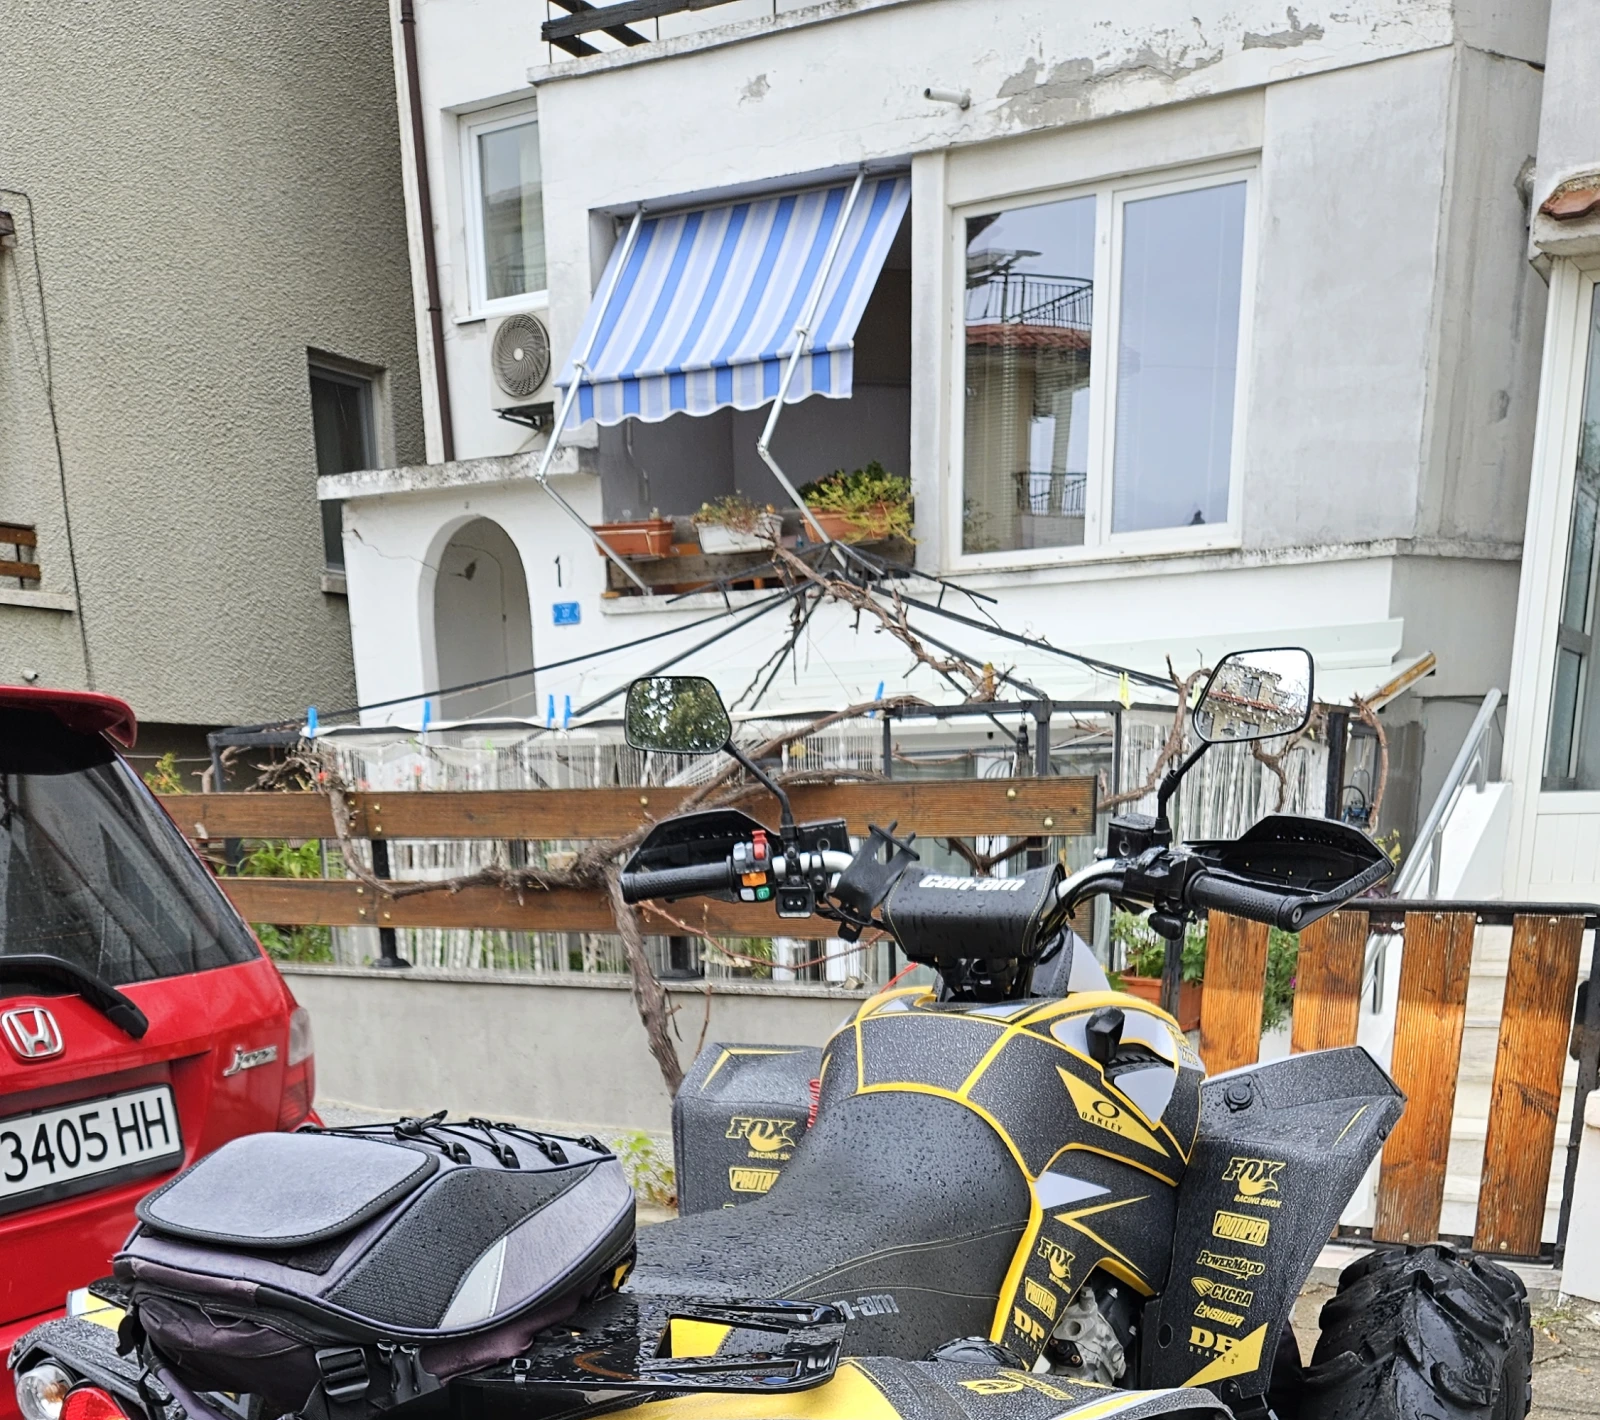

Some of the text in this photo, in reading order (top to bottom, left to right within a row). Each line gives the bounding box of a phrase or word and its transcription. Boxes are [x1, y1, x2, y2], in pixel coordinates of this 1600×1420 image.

[725, 1116, 797, 1145] FOX
[1081, 1111, 1123, 1132] OAKLEY
[0, 1097, 170, 1183] 3405 HH
[729, 1170, 779, 1191] PROTA
[1222, 1157, 1286, 1188] FOX
[1233, 1194, 1282, 1209] RACING SHOX
[1216, 1213, 1267, 1244] PROTAPER
[1037, 1236, 1076, 1270] FOX
[831, 1294, 900, 1320] n-am
[1211, 1283, 1254, 1308] CYCRA
[1014, 1305, 1045, 1342] DP
